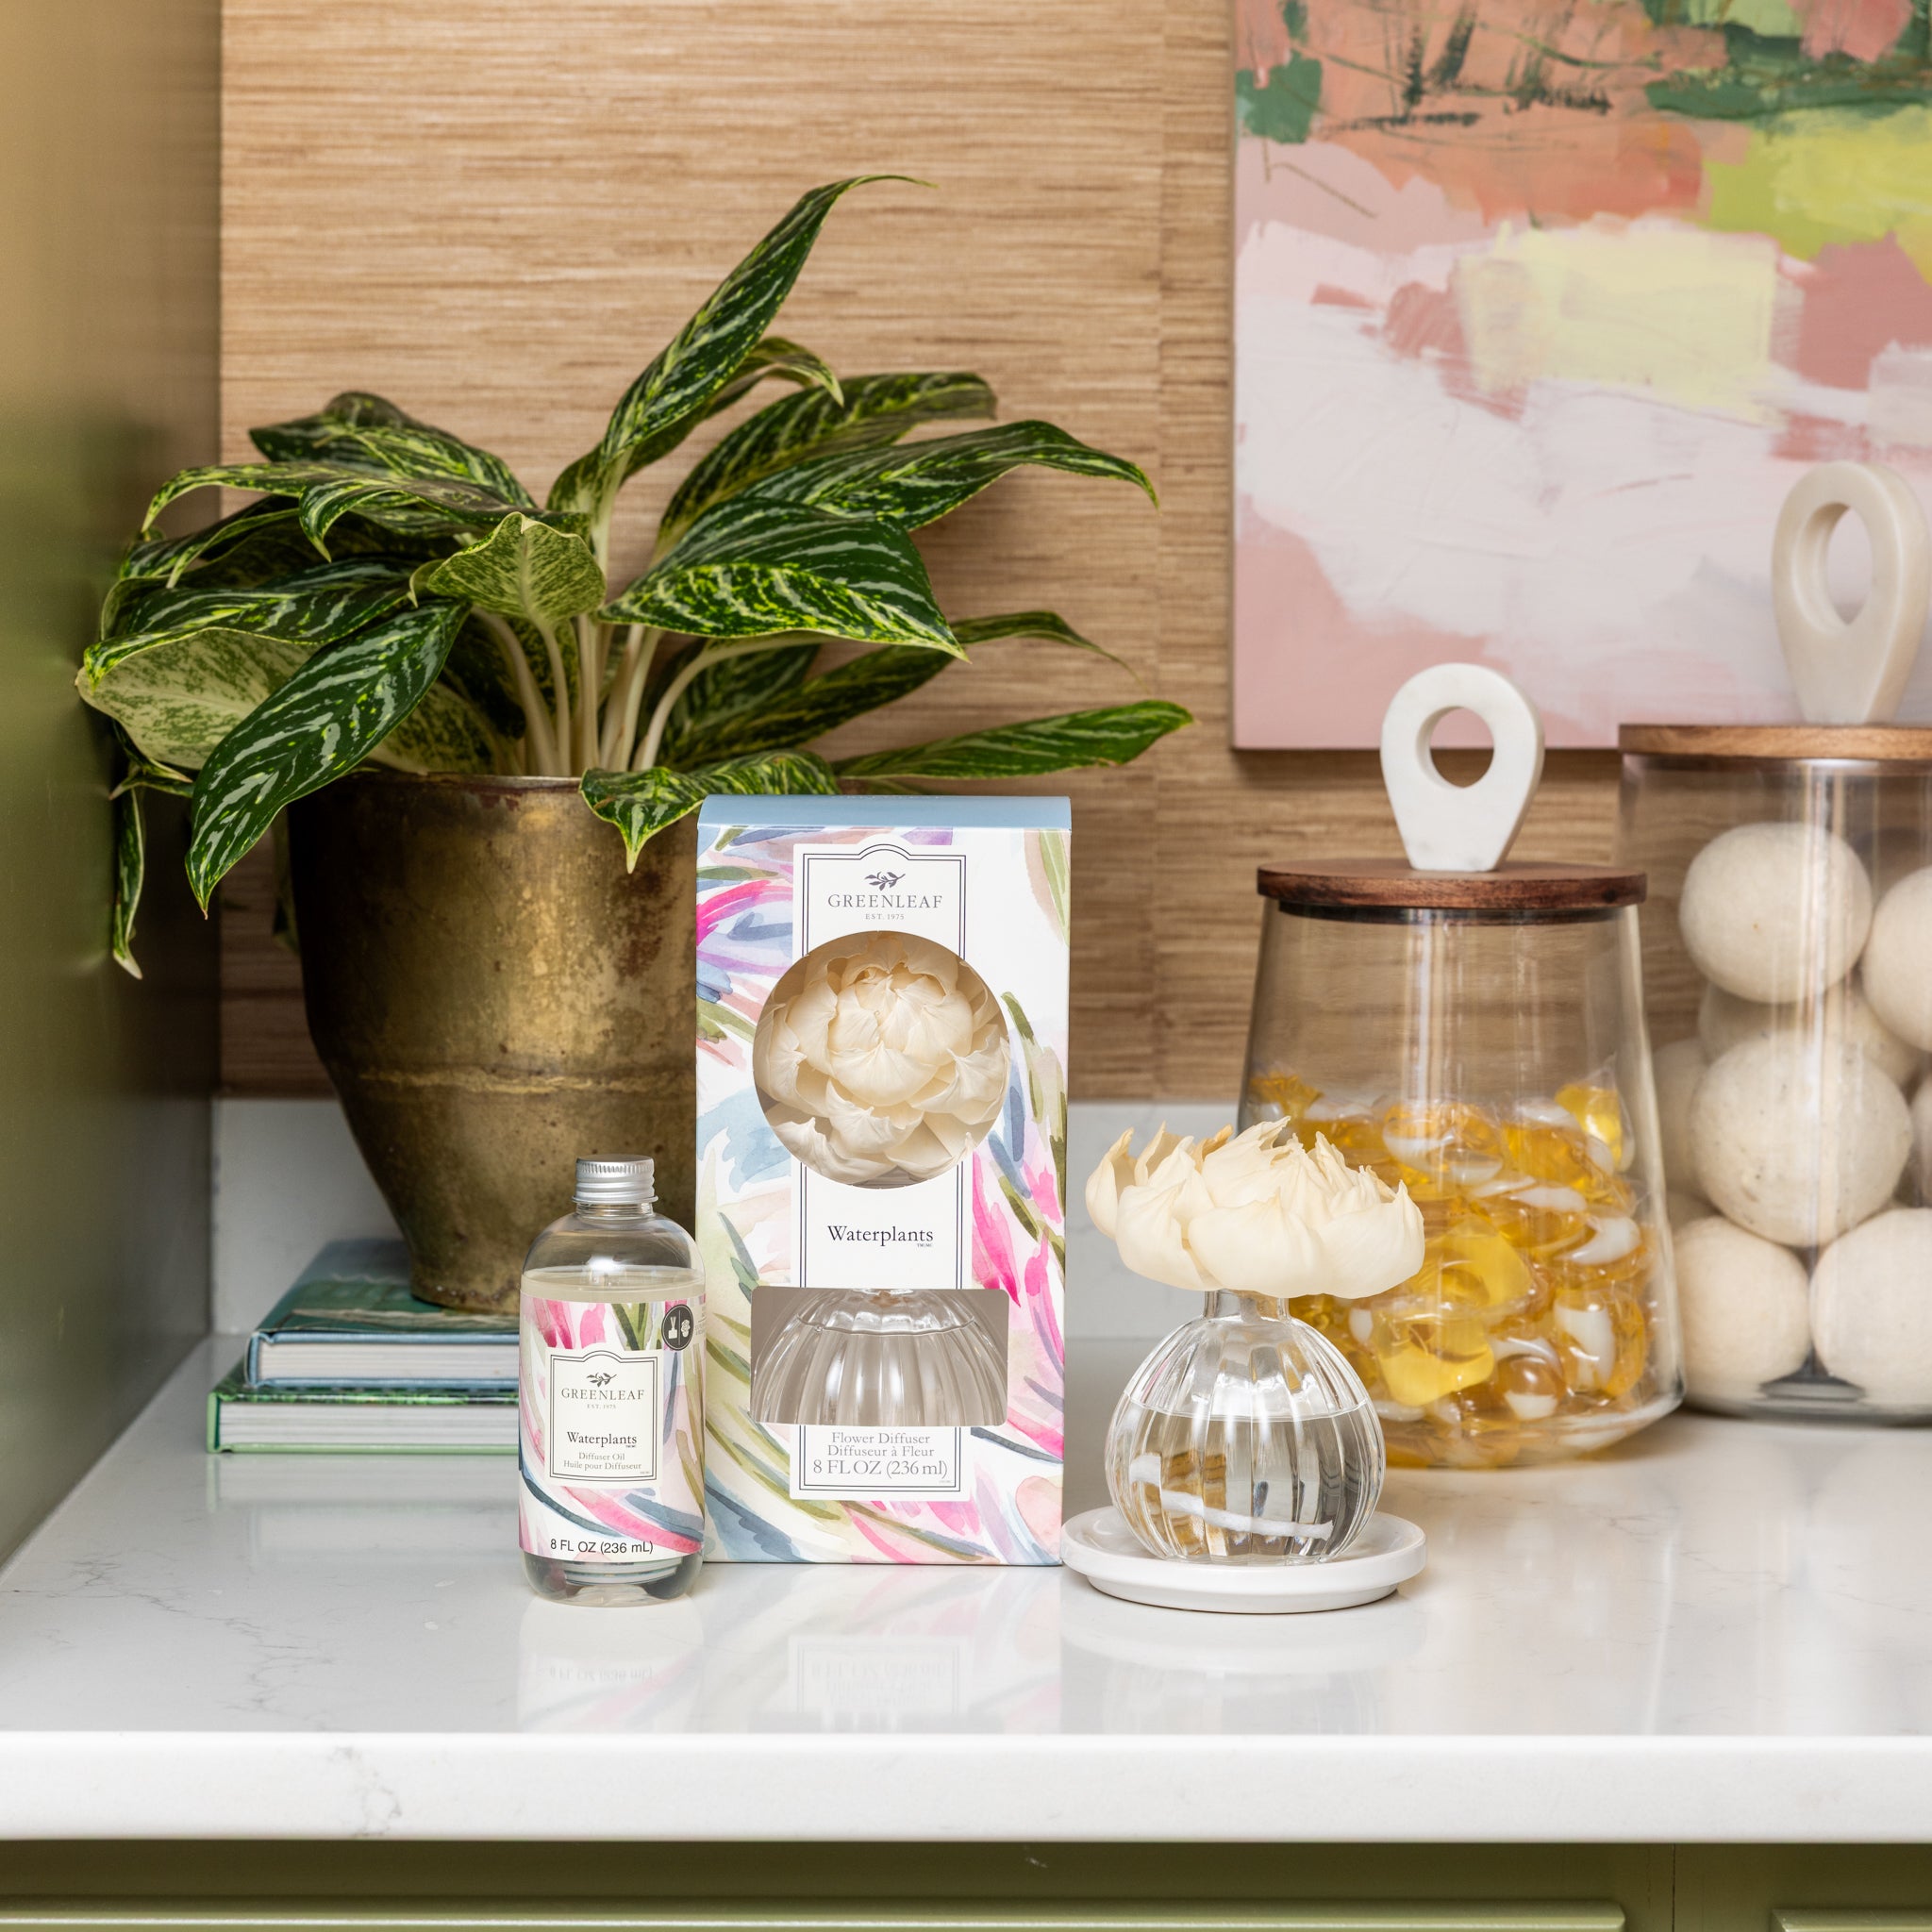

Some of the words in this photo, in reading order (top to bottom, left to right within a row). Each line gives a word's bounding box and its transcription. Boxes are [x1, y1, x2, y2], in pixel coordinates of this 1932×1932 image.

[827, 893, 942, 908] GREENLEAF
[827, 1225, 934, 1247] Waterplants
[561, 1388, 645, 1401] GREENLEAF
[566, 1431, 638, 1448] Waterplants
[831, 1432, 874, 1444] Flower
[878, 1432, 930, 1444] Diffuser
[578, 1452, 609, 1460] Diffuser
[827, 1444, 888, 1457] Diffuseur
[891, 1445, 898, 1457] à
[902, 1445, 935, 1457] Fleur
[563, 1459, 583, 1469] Huile
[584, 1462, 603, 1471] pour
[605, 1461, 641, 1470] Diffuseur
[813, 1459, 823, 1474] 8
[886, 1460, 919, 1479] (236
[550, 1539, 557, 1550] 8
[560, 1540, 575, 1552] FL
[577, 1541, 597, 1553] OZ
[600, 1541, 627, 1555] (236
[631, 1541, 654, 1554] mL)
